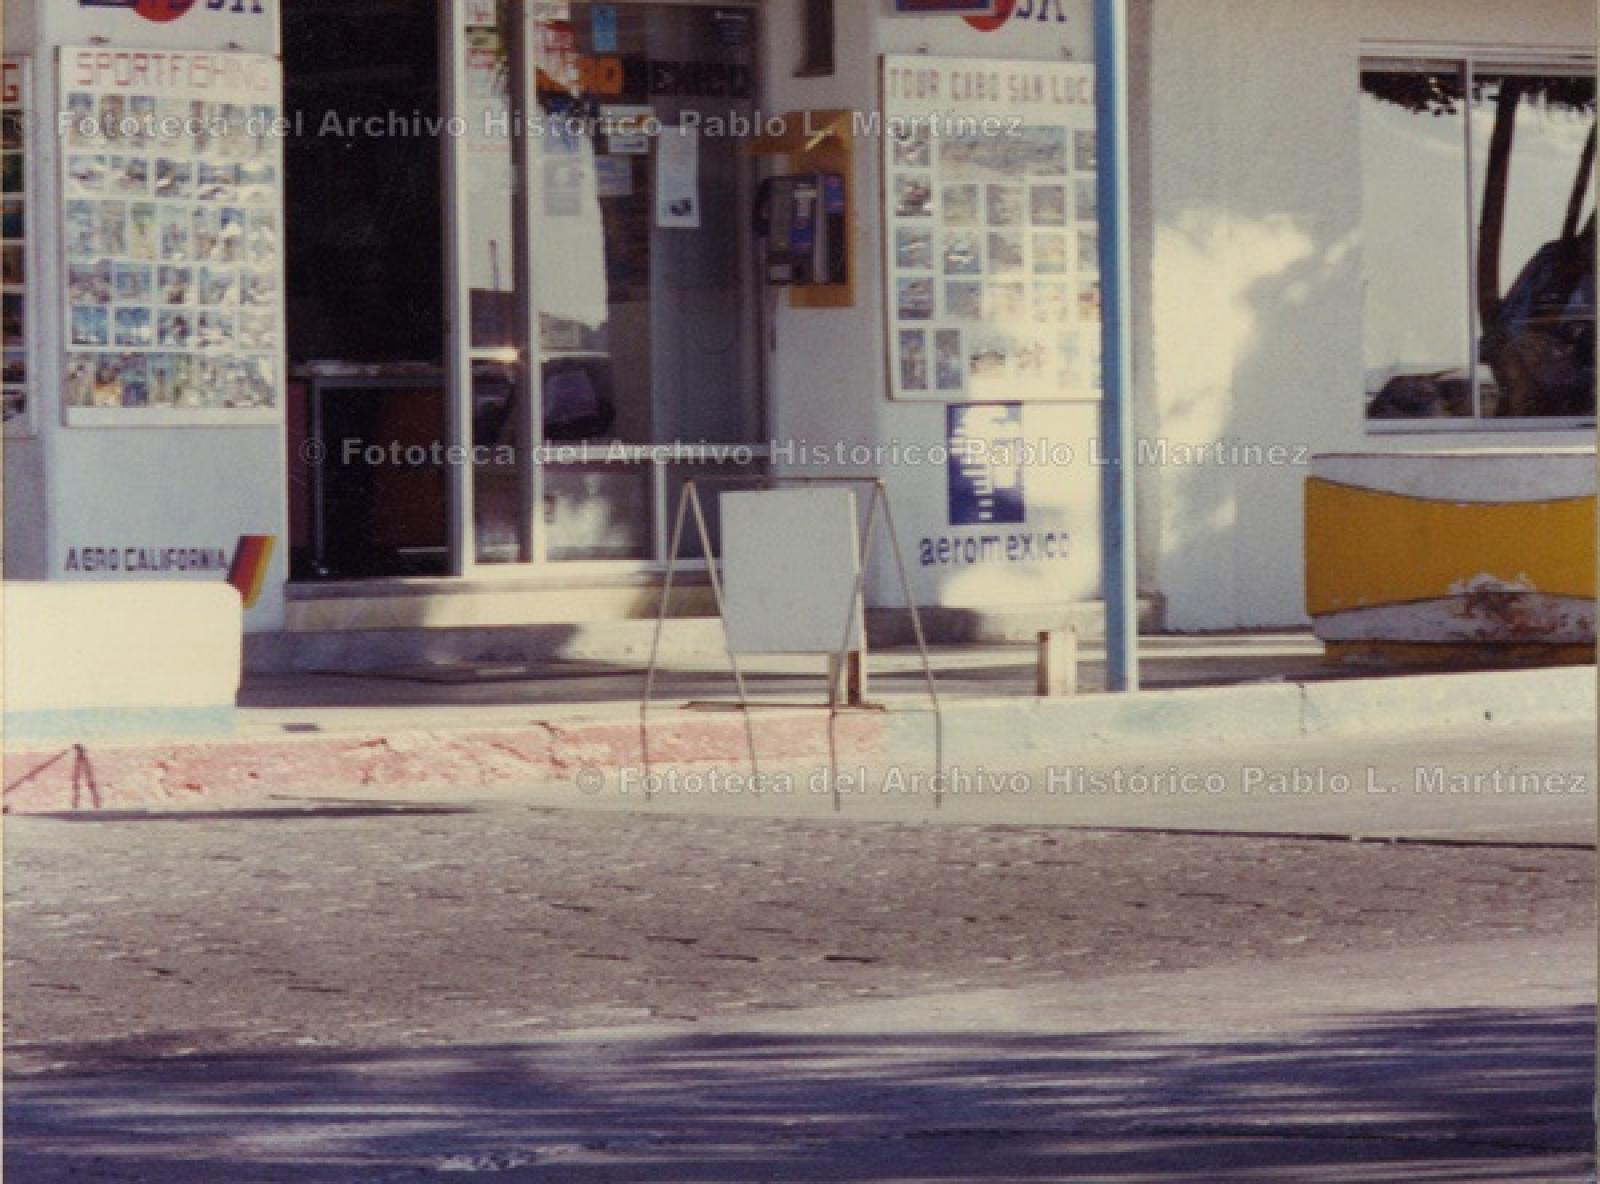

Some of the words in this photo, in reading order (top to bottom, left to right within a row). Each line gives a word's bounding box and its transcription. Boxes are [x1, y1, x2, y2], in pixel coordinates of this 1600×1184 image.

[890, 67, 940, 100] TOUR
[951, 70, 1000, 103] CABO
[1051, 75, 1096, 106] LUC
[64, 547, 119, 571] AERO
[124, 547, 229, 571] CALIFORNIA
